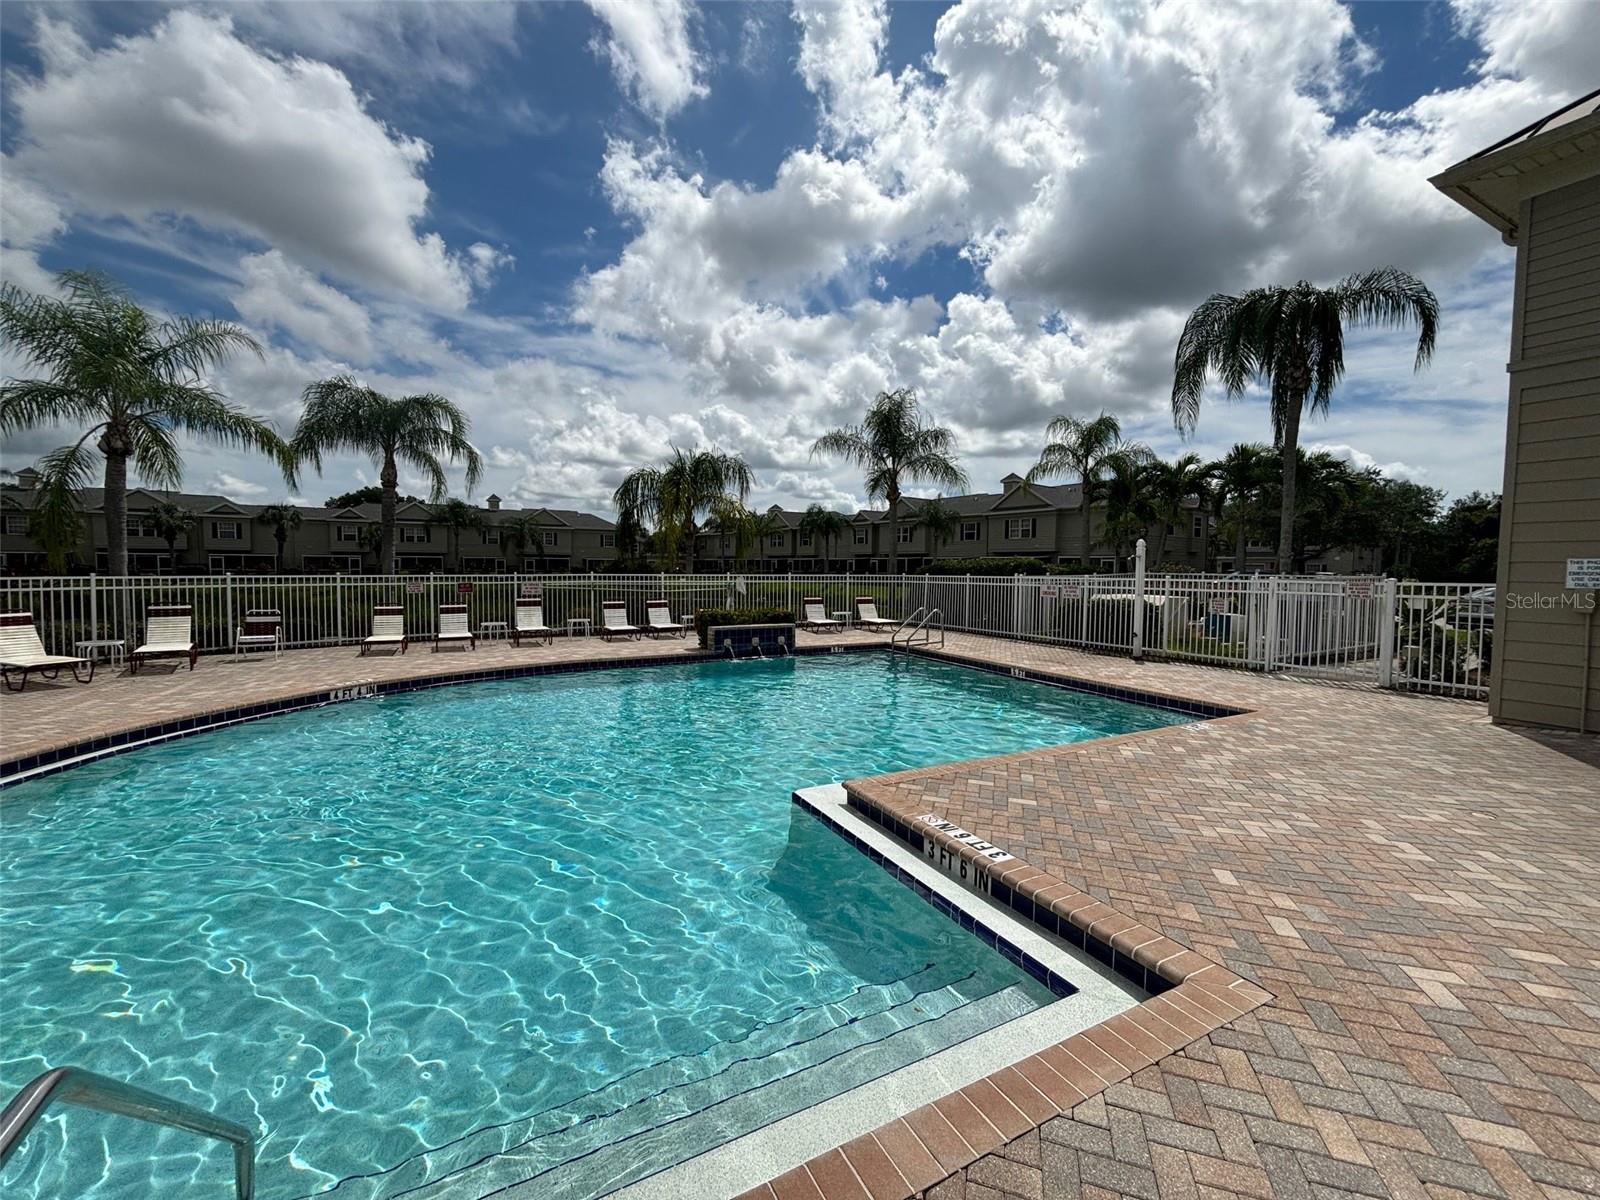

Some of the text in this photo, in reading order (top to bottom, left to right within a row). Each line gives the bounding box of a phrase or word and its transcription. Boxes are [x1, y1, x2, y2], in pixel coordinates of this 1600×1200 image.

[334, 690, 339, 700] 4
[343, 688, 353, 699] FT
[366, 684, 376, 694] IN
[934, 822, 960, 832] IN
[965, 841, 994, 851] FT
[988, 851, 1008, 859] 3
[928, 840, 989, 893] 3 FT 6 IN
